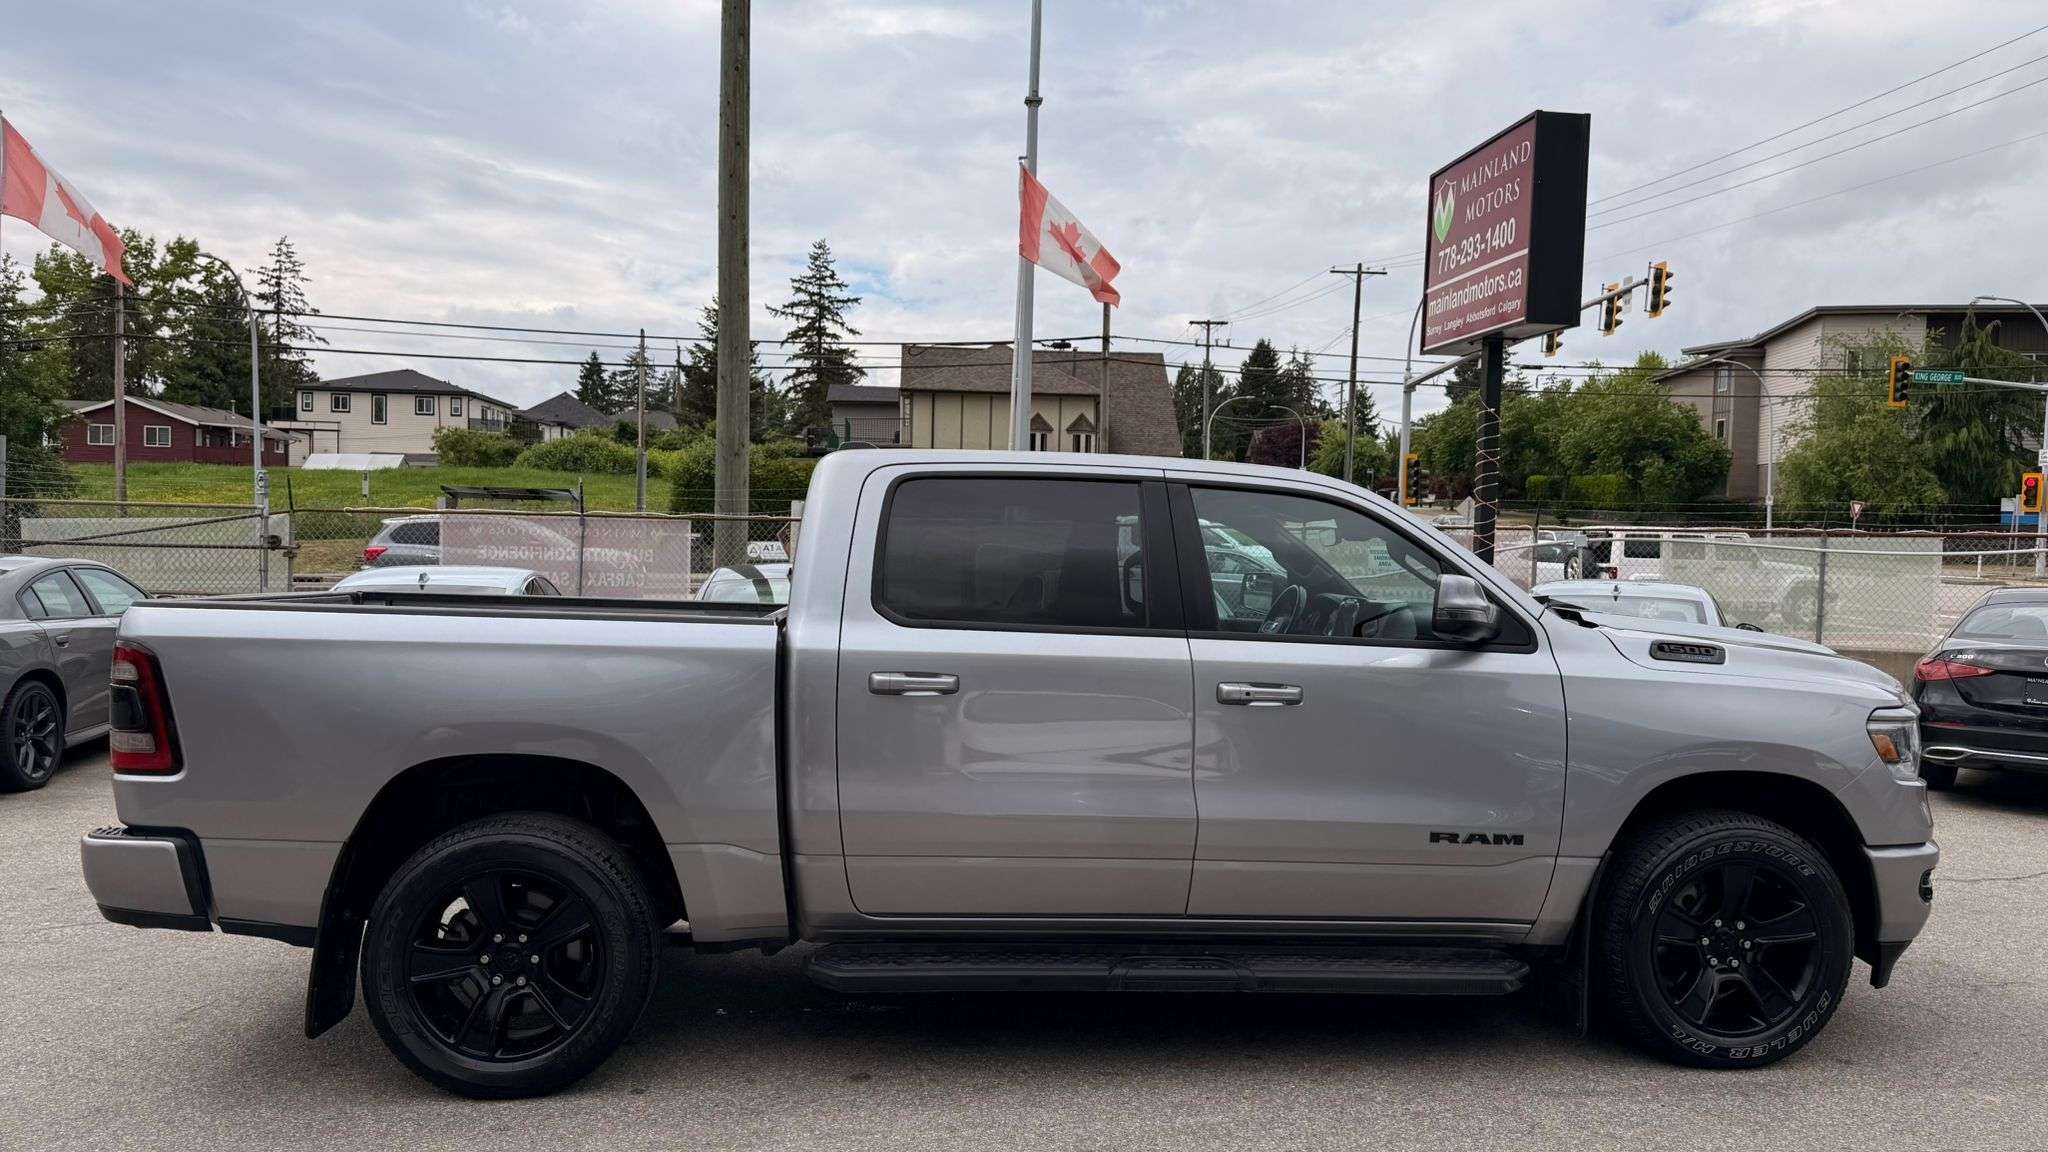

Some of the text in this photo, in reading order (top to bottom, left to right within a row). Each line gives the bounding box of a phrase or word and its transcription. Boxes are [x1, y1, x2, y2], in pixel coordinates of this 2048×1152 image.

[1460, 141, 1531, 196] MAINLAND
[1465, 178, 1520, 224] MOTORS
[1438, 217, 1516, 274] 778-293-1400
[1428, 267, 1522, 317] mainlandmotors.ca
[1914, 372, 1929, 381] KING
[1930, 372, 1952, 383] GEORGE
[1657, 642, 1715, 656] 1500
[1429, 832, 1525, 846] RAM
[1649, 841, 1816, 914] BRIDGESTONE
[1729, 990, 1832, 1058] DUELER
